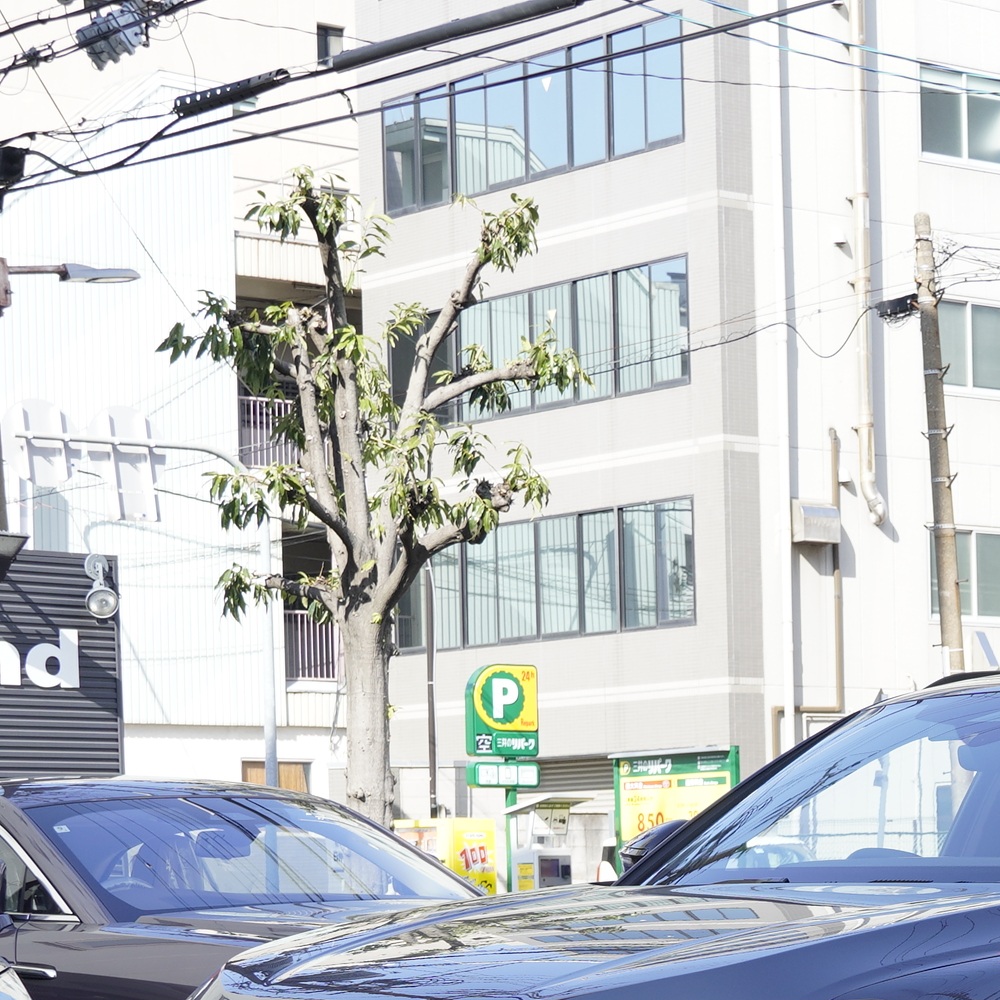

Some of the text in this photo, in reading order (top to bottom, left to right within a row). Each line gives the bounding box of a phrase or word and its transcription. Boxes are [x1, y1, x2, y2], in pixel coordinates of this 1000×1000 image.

[492, 677, 519, 719] P
[476, 733, 492, 753] 空
[497, 737, 536, 751] 三井のリパーク
[633, 757, 672, 775] 三井のリパーク
[637, 811, 664, 832] 850
[459, 845, 488, 872] 100
